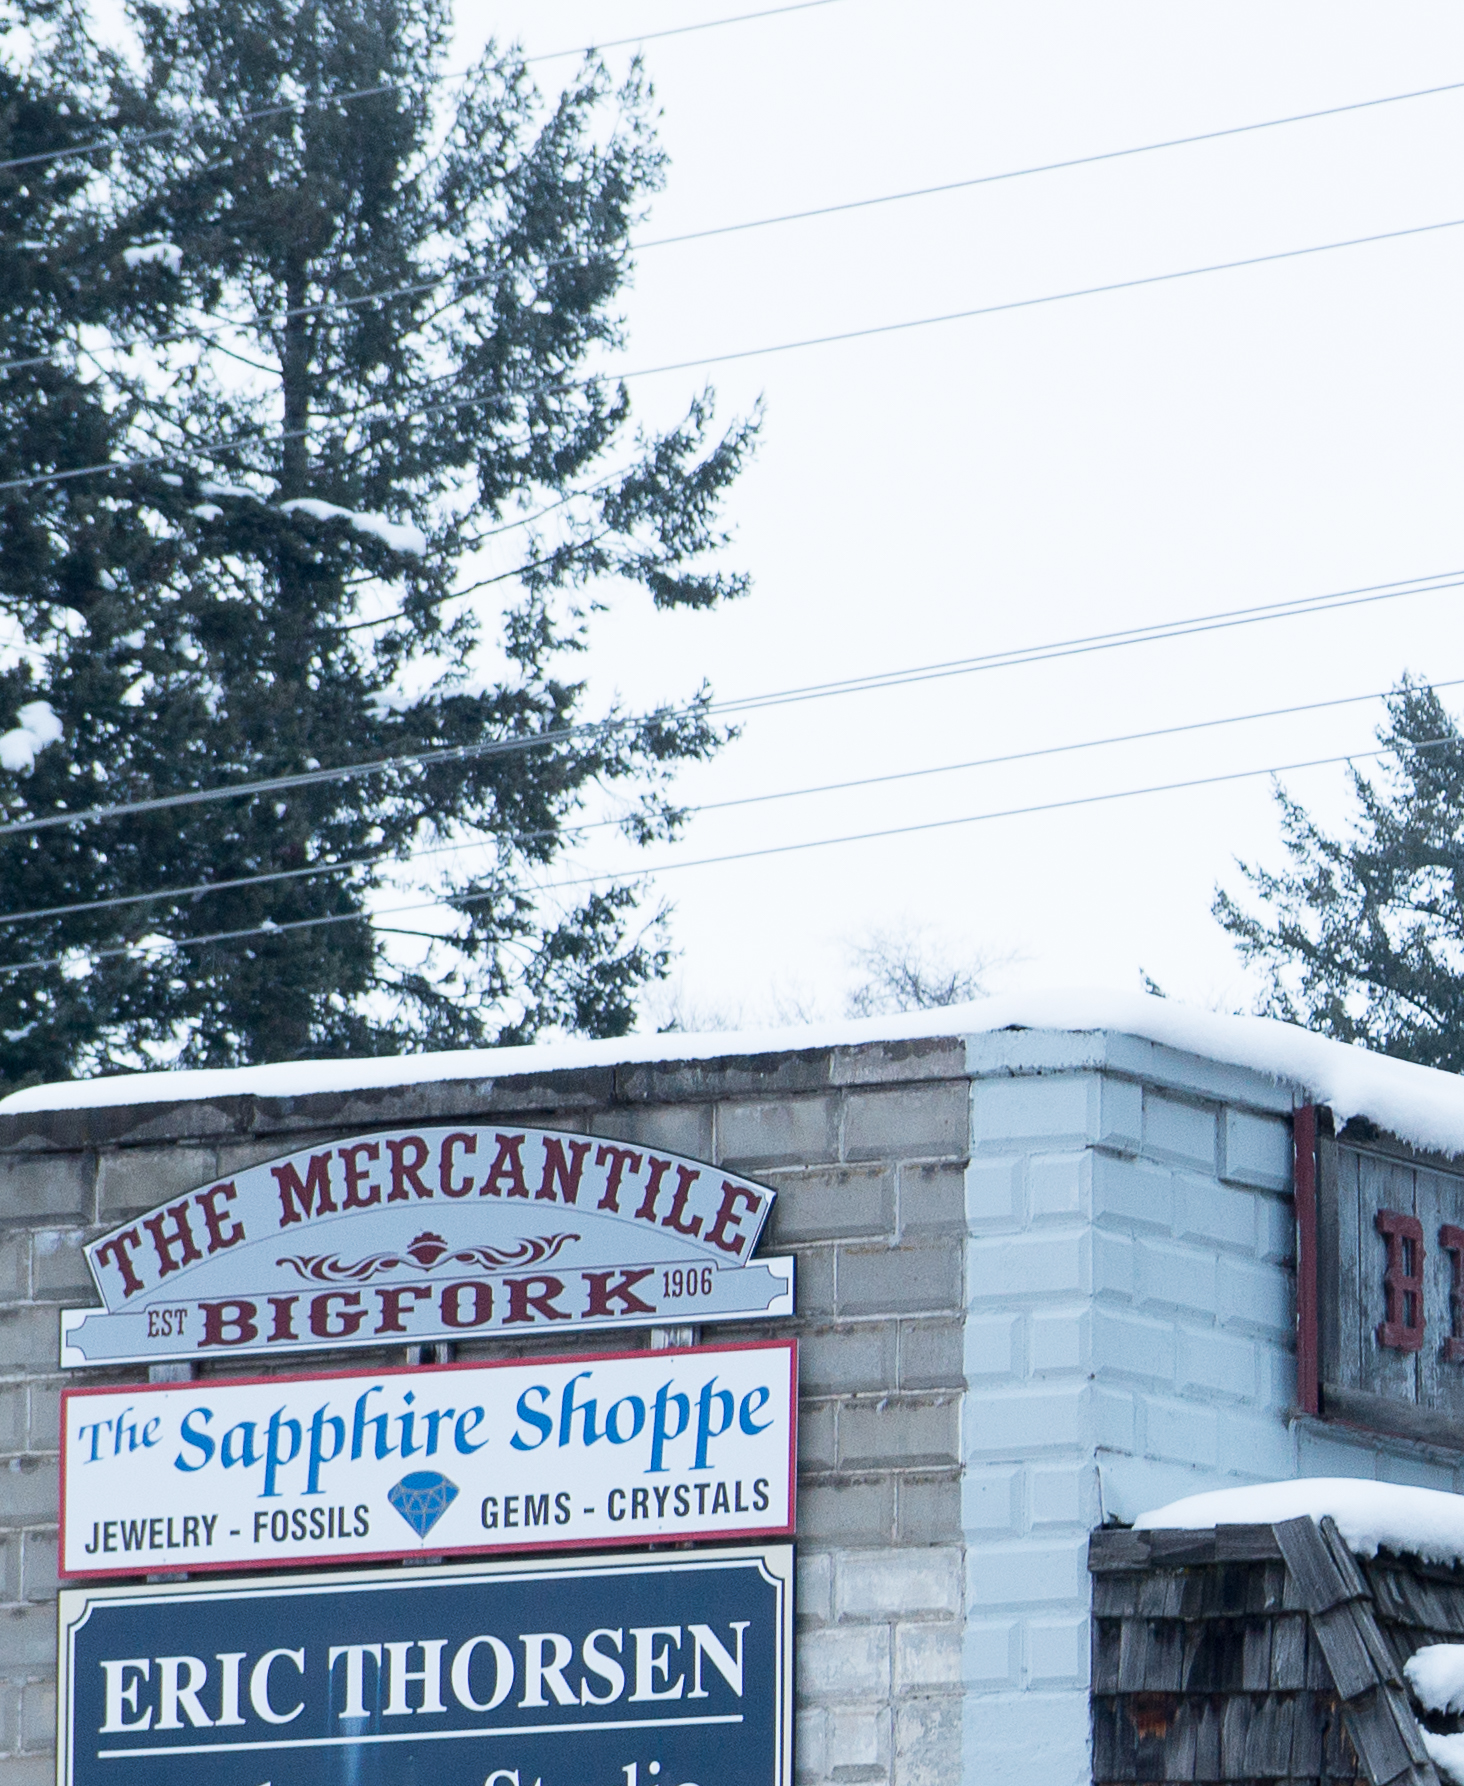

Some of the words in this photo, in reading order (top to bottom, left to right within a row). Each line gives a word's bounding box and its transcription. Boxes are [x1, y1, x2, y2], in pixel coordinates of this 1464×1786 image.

[97, 1181, 245, 1298] THE
[278, 1132, 763, 1256] MERCANTILE
[146, 1308, 188, 1338] EST
[197, 1266, 659, 1350] BIGFORK
[662, 1267, 714, 1299] 1906
[78, 1404, 164, 1466] The
[173, 1384, 490, 1499] Sapphire
[509, 1370, 775, 1474] Shoppe
[84, 1513, 219, 1555] JEWELRY
[253, 1503, 371, 1545] FOSSILS
[480, 1492, 572, 1530] GEMS
[606, 1477, 772, 1522] CRYSTALS
[98, 1645, 307, 1735] ERIC
[327, 1620, 752, 1721] THORSEN
